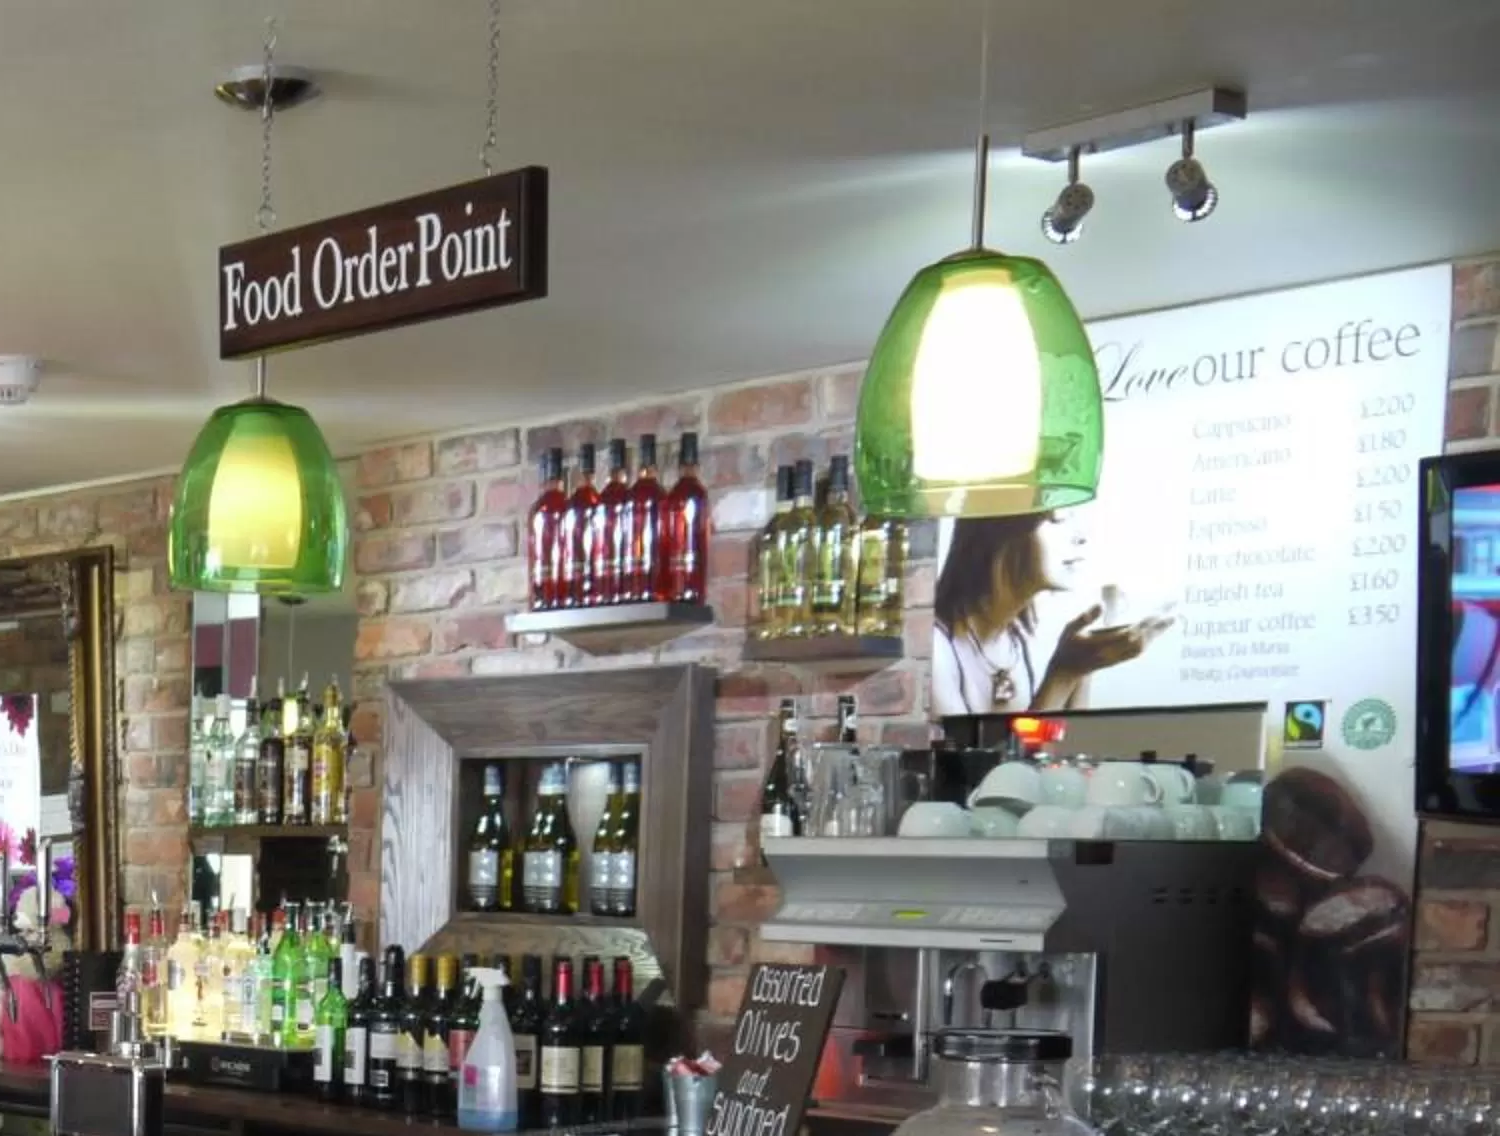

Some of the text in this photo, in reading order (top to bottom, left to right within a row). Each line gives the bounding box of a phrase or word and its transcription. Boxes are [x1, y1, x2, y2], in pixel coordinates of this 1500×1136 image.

[222, 202, 513, 332] Food Order Point
[1193, 345, 1265, 386] our
[1281, 318, 1423, 374] coffee
[1184, 579, 1250, 607] English
[1254, 582, 1285, 600] tea
[1178, 614, 1254, 642] Liqueur
[1257, 611, 1318, 634] coffee
[735, 1009, 802, 1063] Olives
[736, 1066, 772, 1100] and
